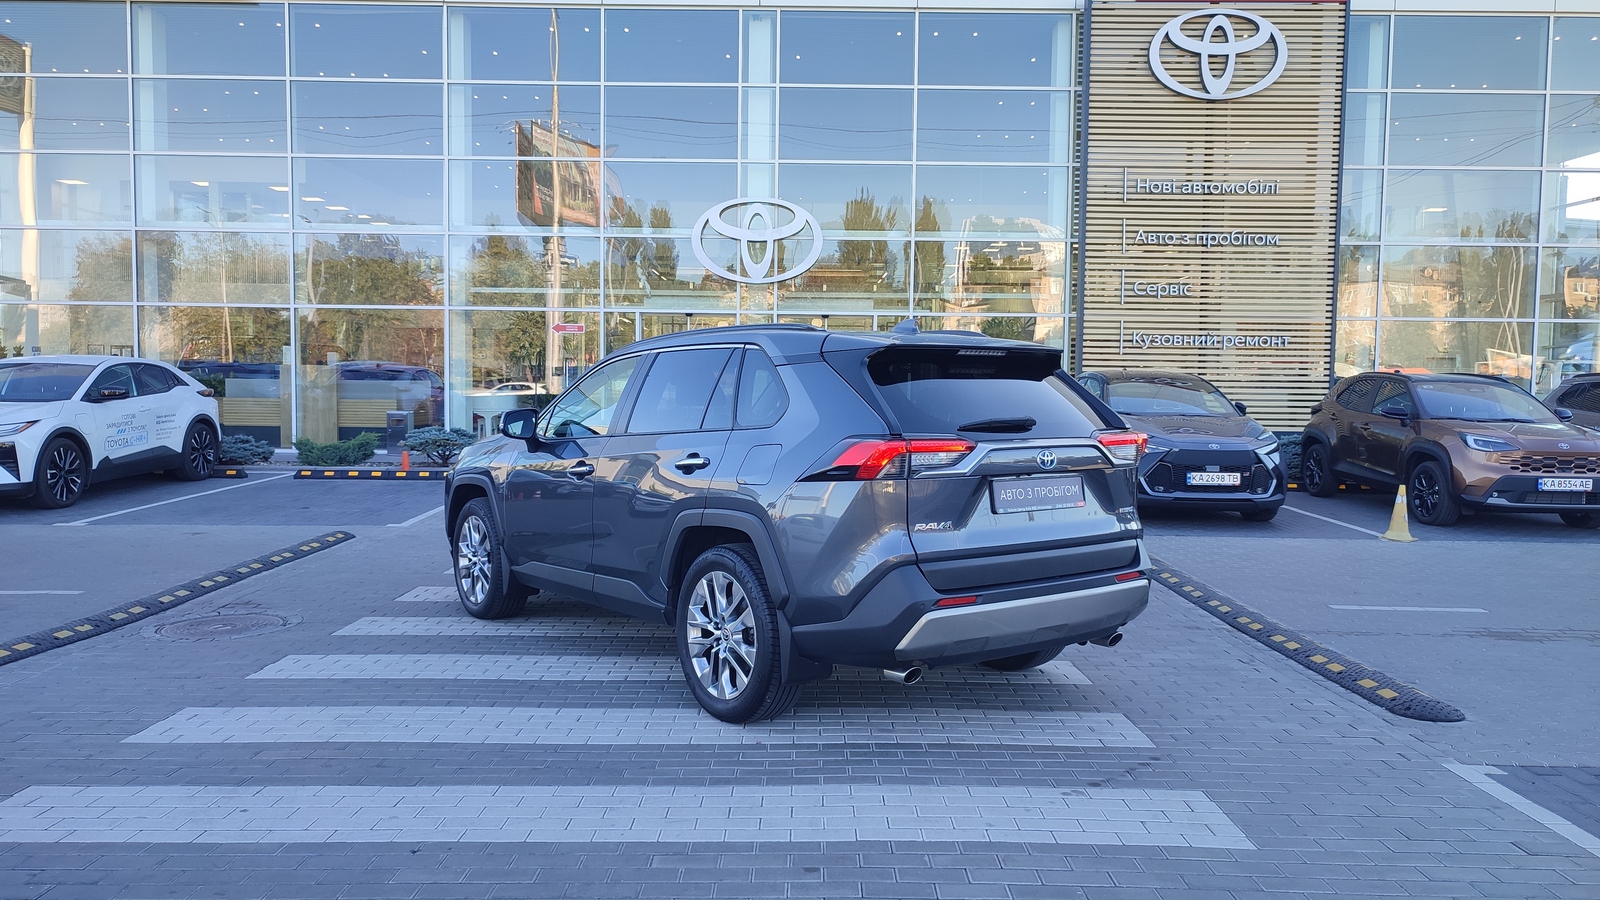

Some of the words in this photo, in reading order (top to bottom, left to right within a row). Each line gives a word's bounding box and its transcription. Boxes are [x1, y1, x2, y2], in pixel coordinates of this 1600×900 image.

[1135, 178, 1176, 194] Нові
[1181, 178, 1280, 195] автомобілі
[1134, 229, 1176, 245] Авто
[1180, 233, 1190, 245] з
[1196, 230, 1279, 248] пробігом
[1132, 280, 1193, 299] Сервіс
[1131, 331, 1217, 349] Кузовний
[1222, 334, 1291, 350] ремонт
[106, 437, 129, 448] TOYOTA
[129, 434, 146, 444] C-HR+
[1205, 474, 1226, 483] 2698
[1227, 474, 1239, 483] TB
[1543, 480, 1556, 488] KA
[1557, 479, 1578, 489] 8554
[1579, 480, 1591, 488] AE
[1000, 488, 1025, 501] АВТО
[1027, 487, 1033, 499] З
[1034, 484, 1080, 498] ПРОБІГОМ
[914, 520, 954, 532] RAV4
